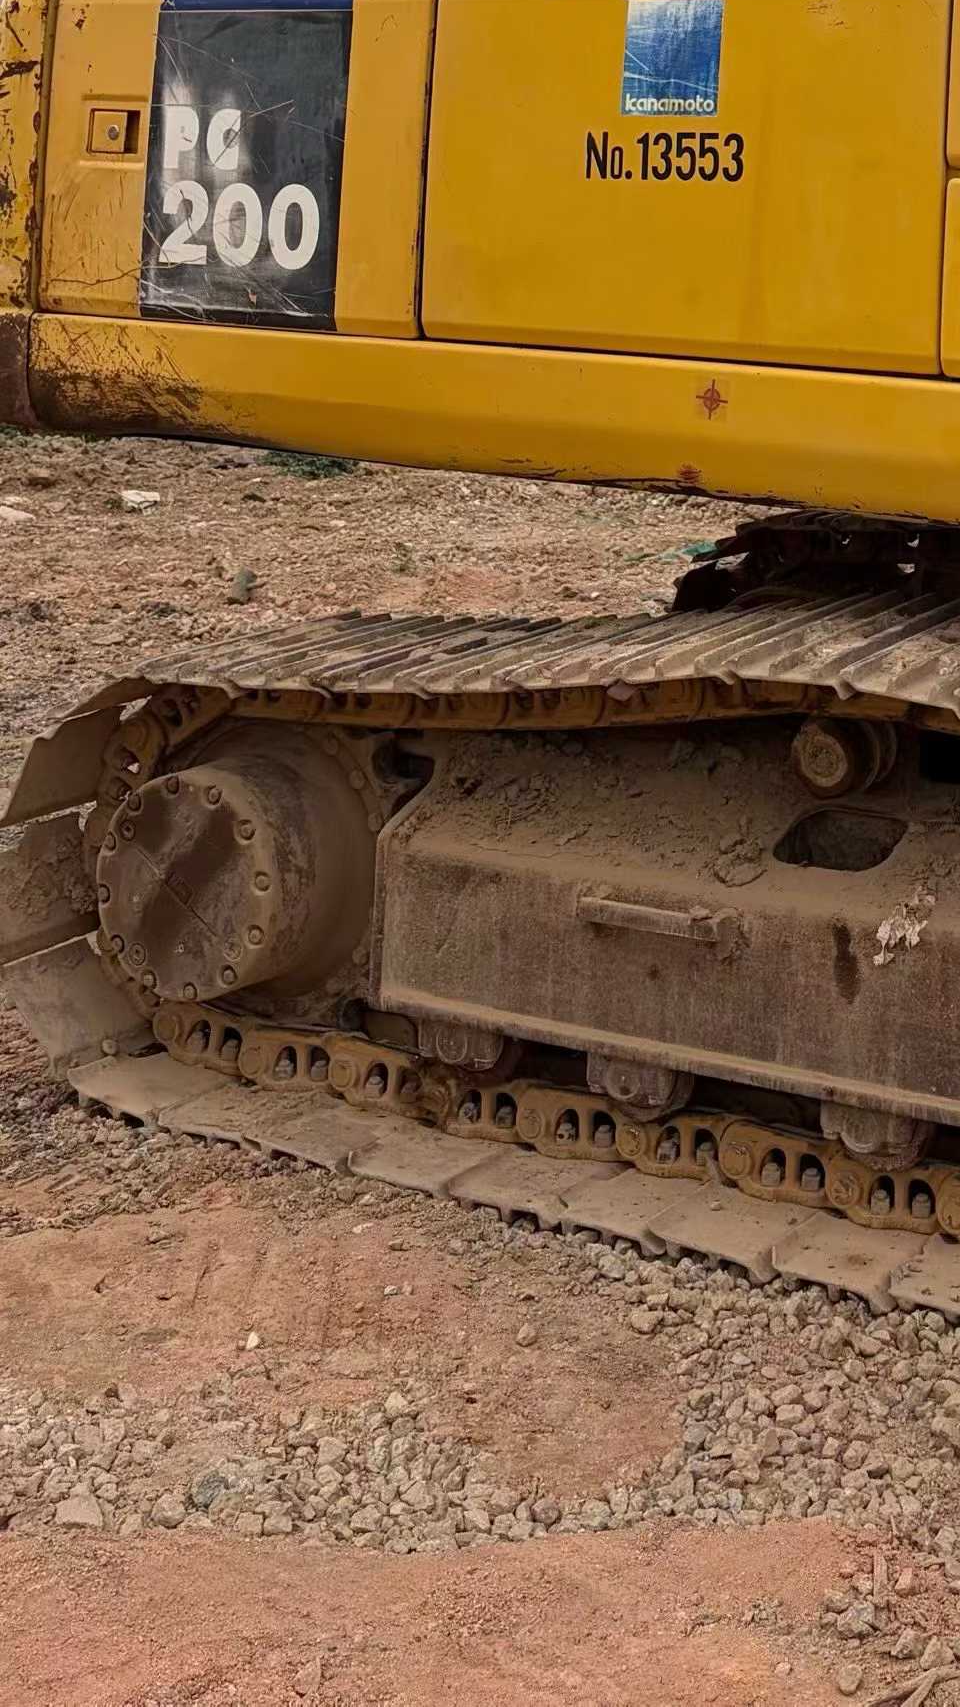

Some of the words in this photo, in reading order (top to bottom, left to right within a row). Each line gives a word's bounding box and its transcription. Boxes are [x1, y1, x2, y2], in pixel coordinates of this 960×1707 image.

[625, 94, 715, 112] kanamoto
[163, 108, 241, 170] PC
[158, 180, 320, 270] 200
